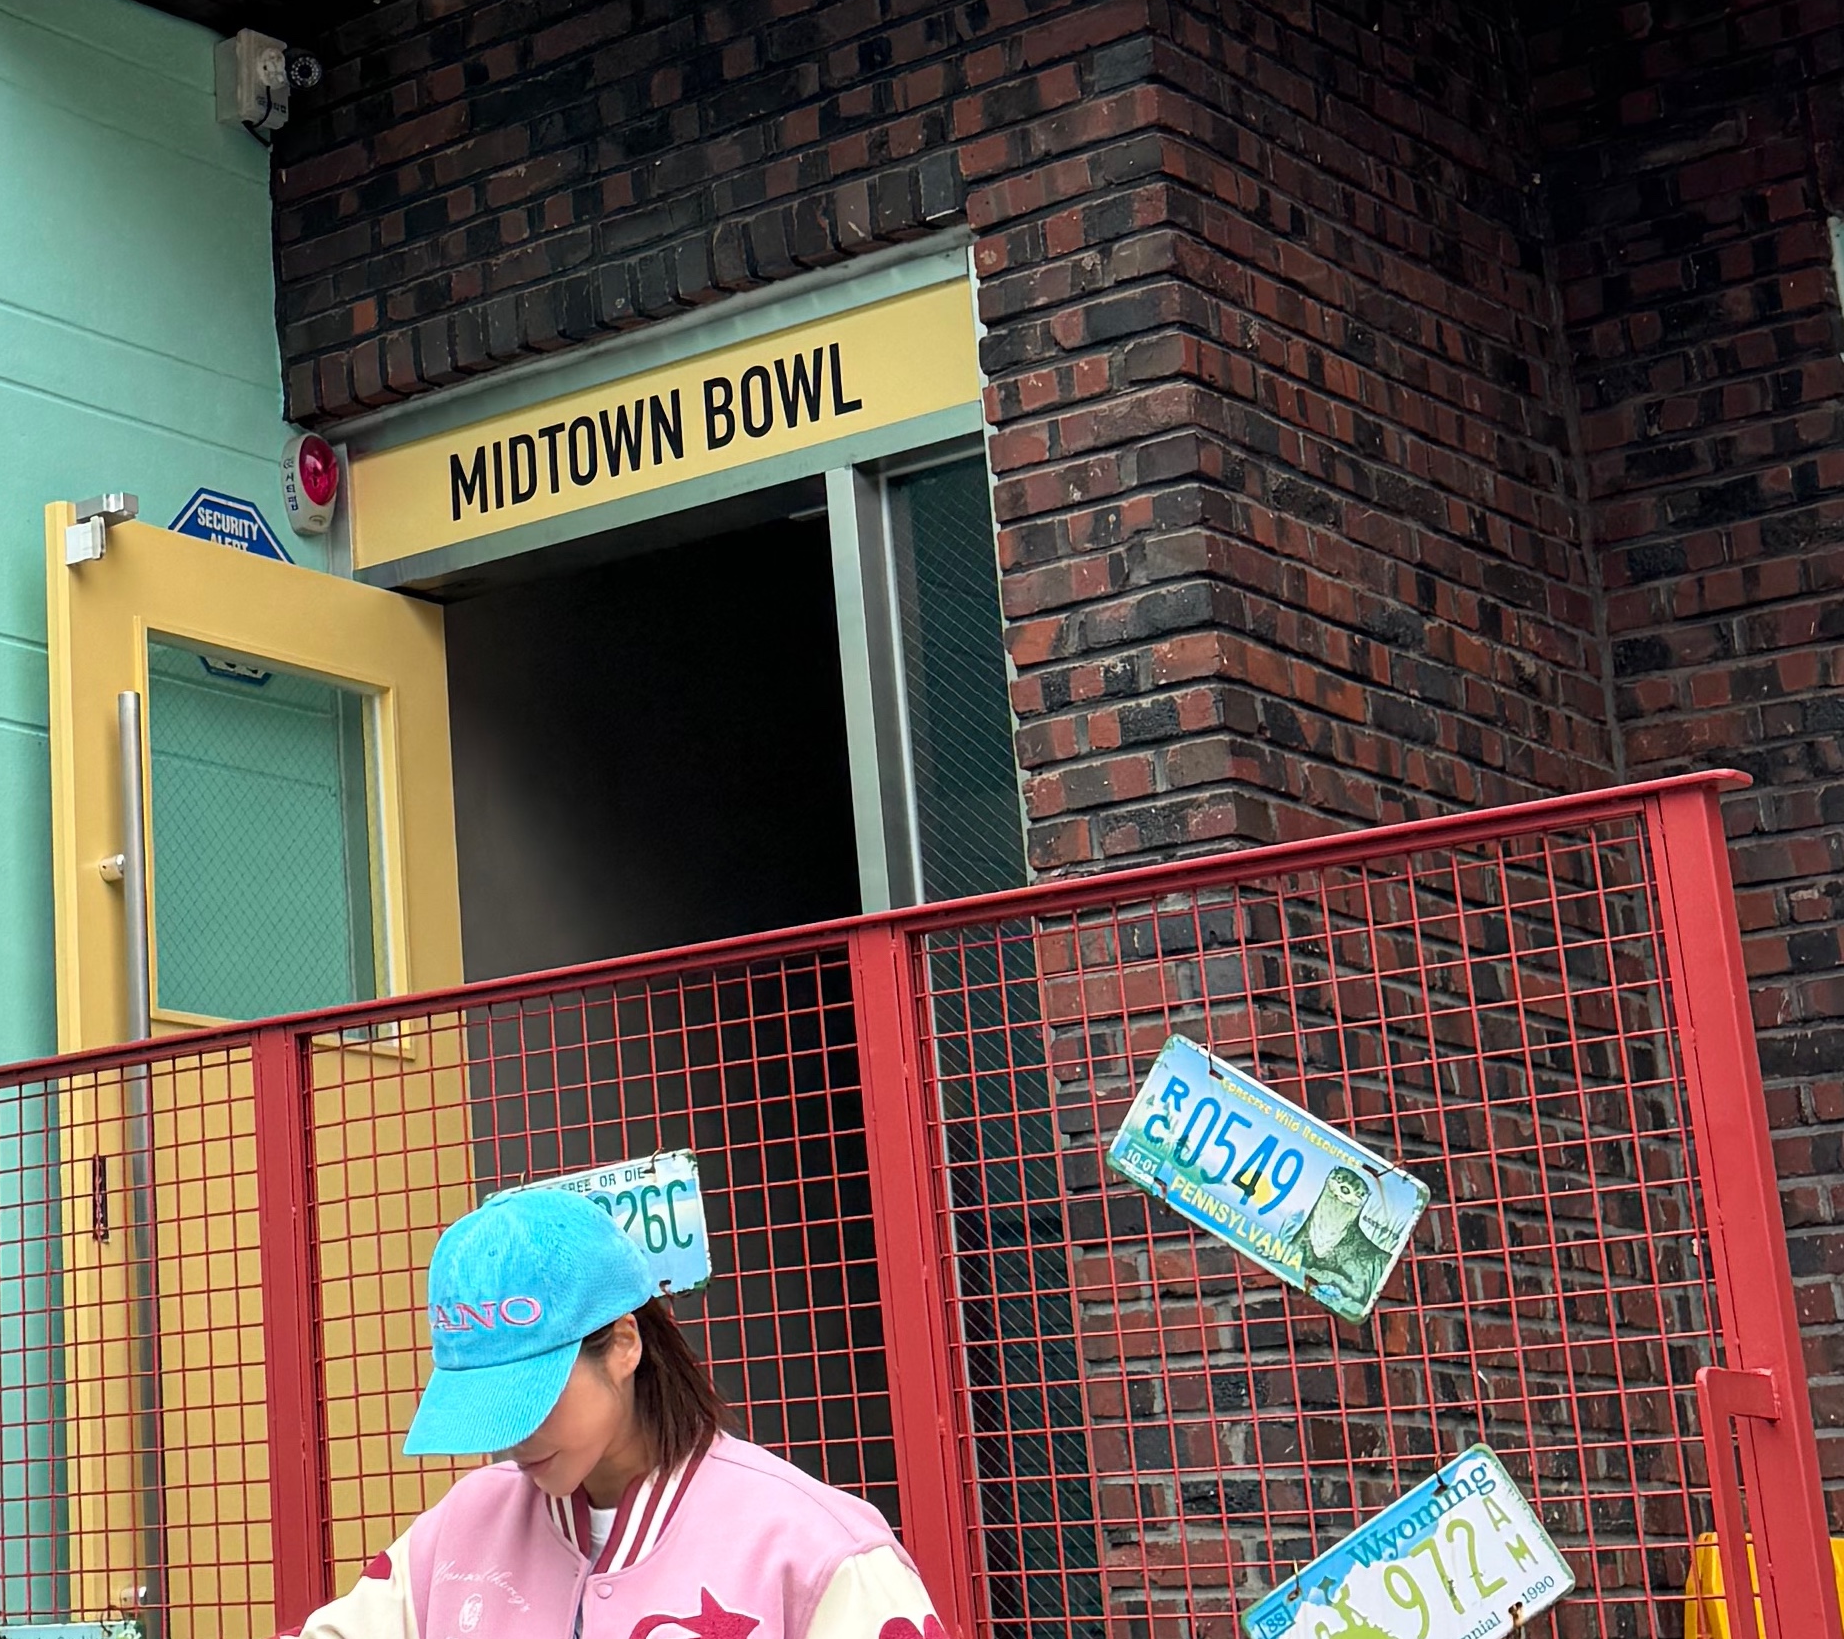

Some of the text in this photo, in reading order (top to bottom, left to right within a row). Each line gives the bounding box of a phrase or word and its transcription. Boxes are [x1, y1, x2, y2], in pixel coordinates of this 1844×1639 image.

[448, 342, 863, 522] MIDTOWN BOWL
[197, 506, 259, 541] SECURITY
[599, 1173, 617, 1188] OR
[624, 1167, 646, 1182] DIE
[1174, 1097, 1304, 1216] 0549
[1170, 1176, 1304, 1273] PENNSYLVANIA
[1346, 1462, 1497, 1569] Wyoming
[1521, 1575, 1556, 1604] 1990
